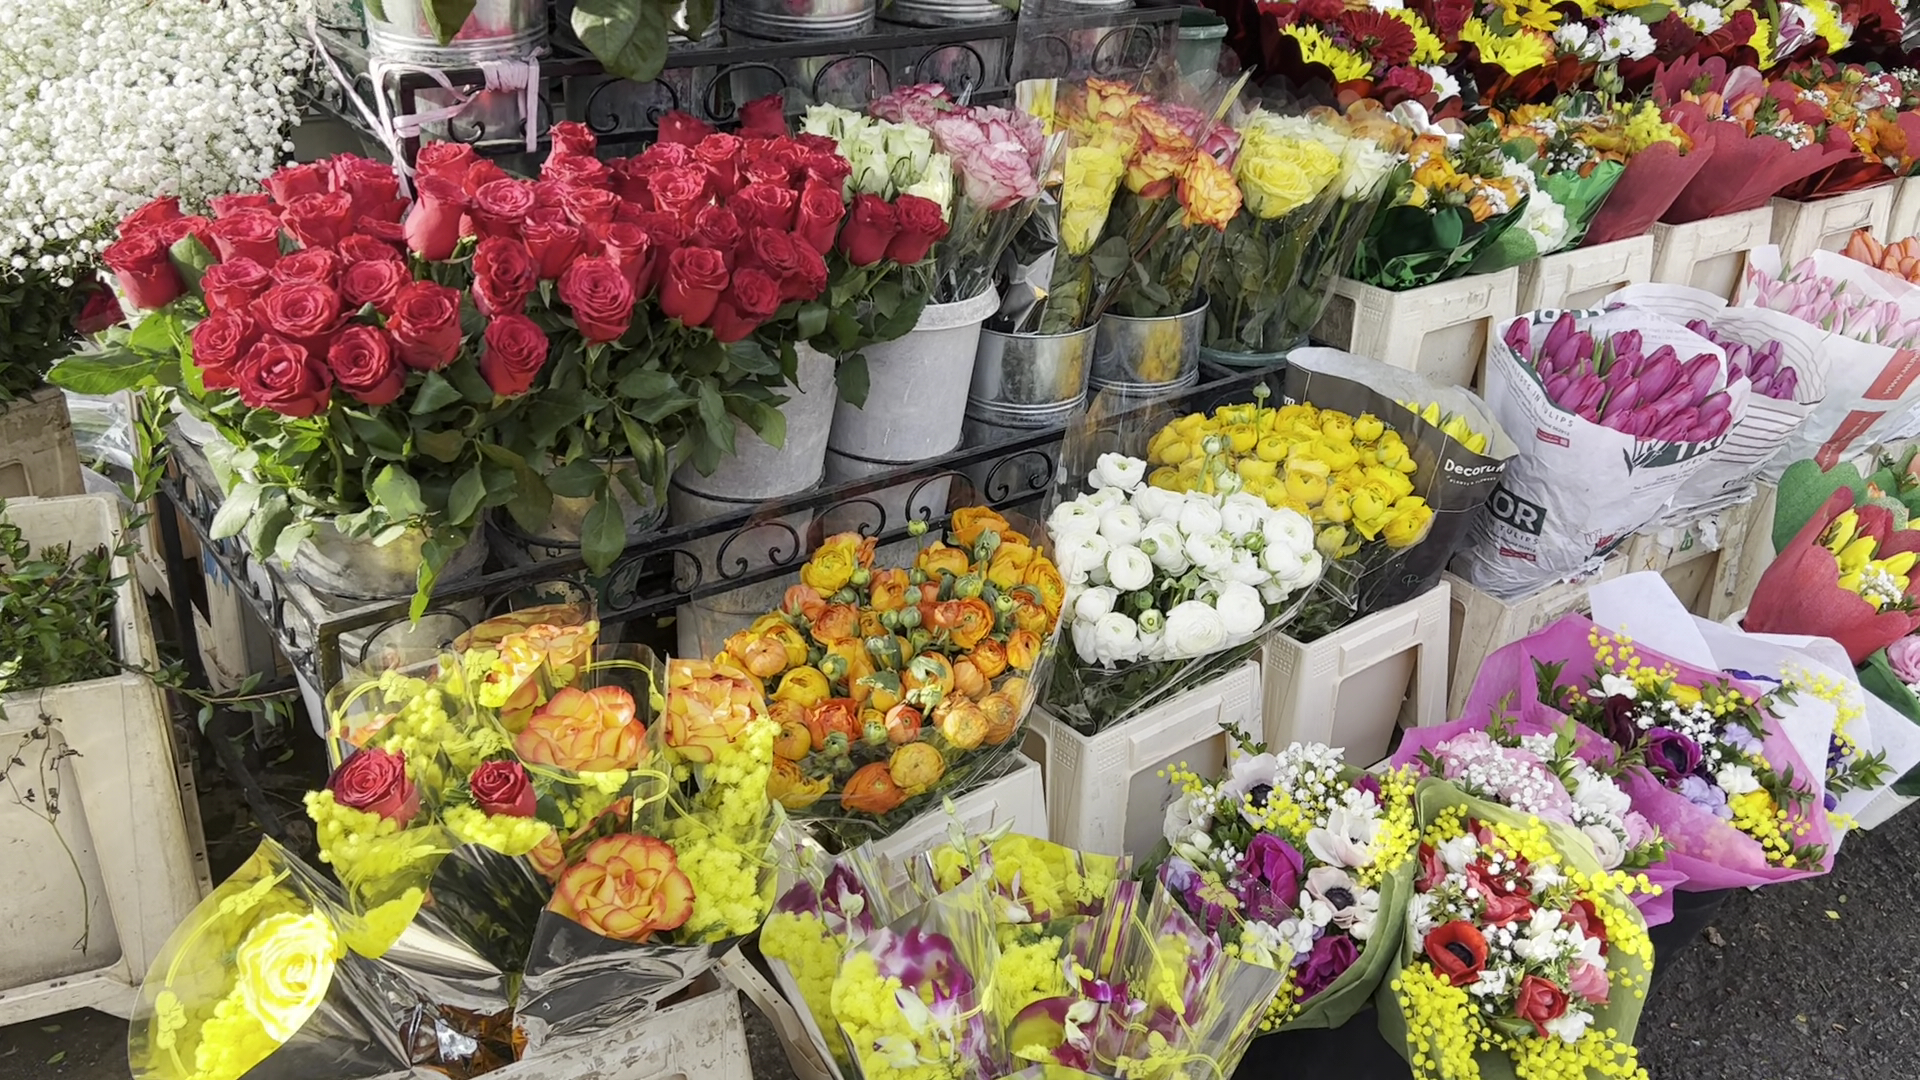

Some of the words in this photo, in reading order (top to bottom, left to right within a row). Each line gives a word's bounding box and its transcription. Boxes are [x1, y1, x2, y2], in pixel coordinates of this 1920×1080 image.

[1541, 401, 1574, 428] TULIPS
[1488, 490, 1539, 532] OR
[1499, 524, 1540, 546] TULIPS
